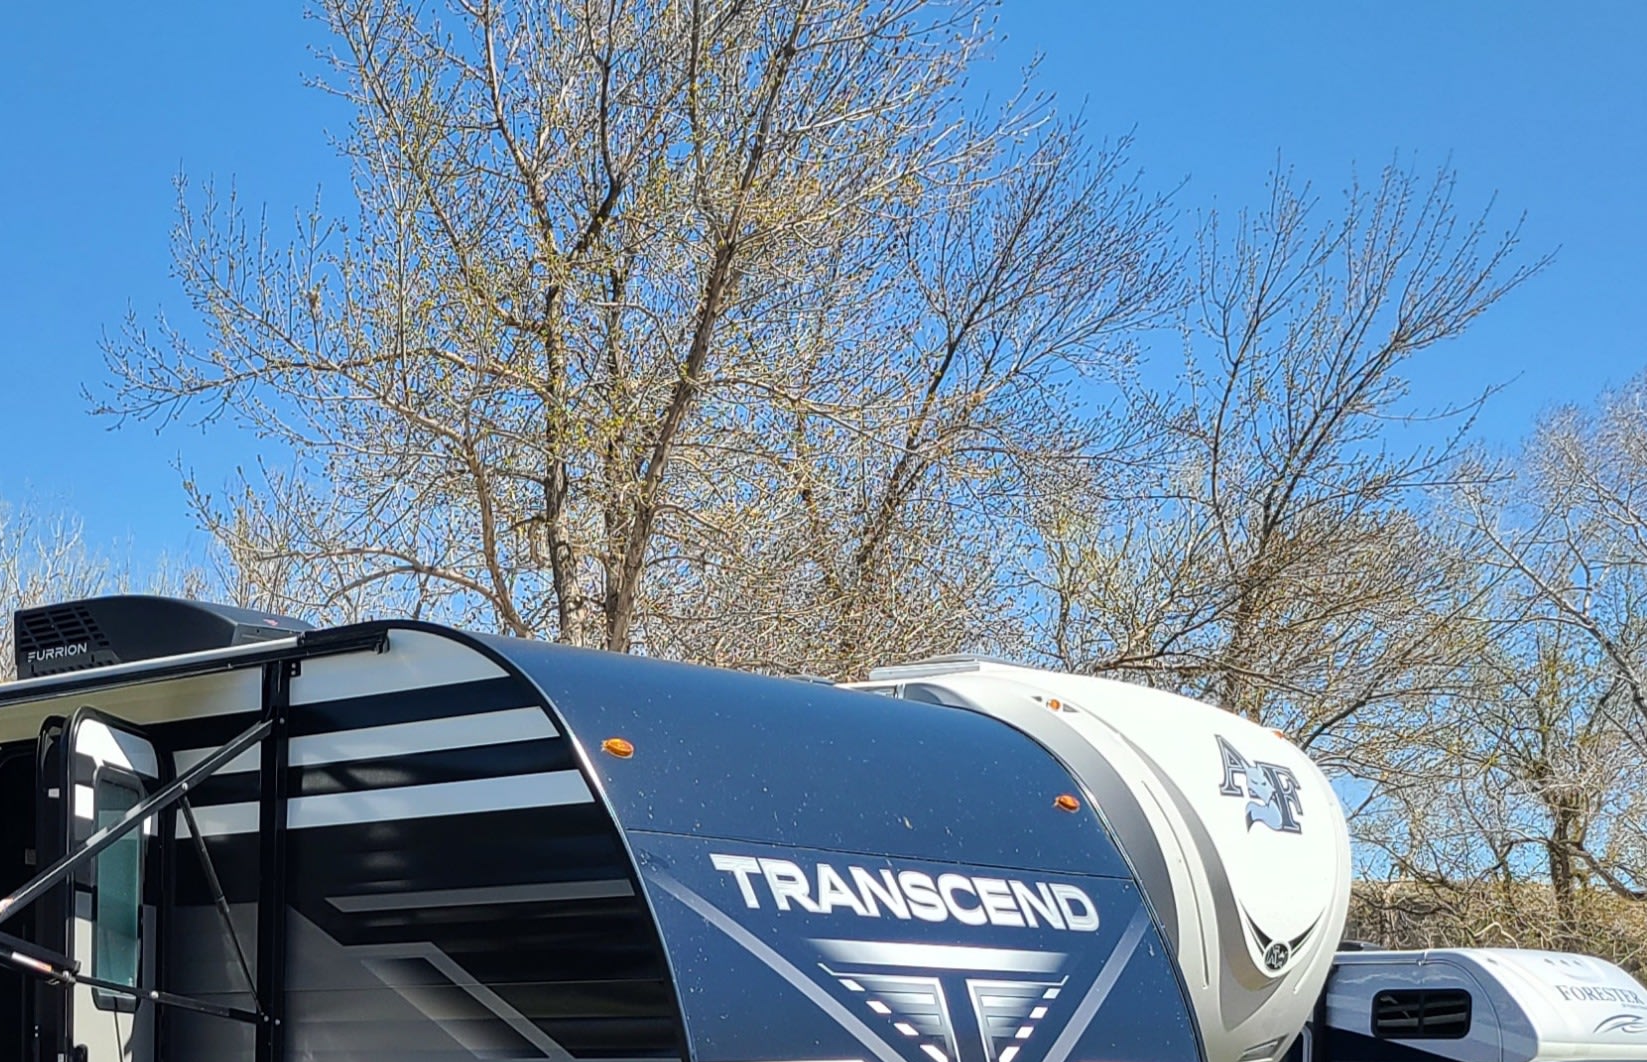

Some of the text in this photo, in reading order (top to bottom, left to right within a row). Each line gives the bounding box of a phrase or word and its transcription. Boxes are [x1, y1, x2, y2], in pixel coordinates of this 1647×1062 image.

[27, 642, 88, 663] FURRION
[708, 853, 1100, 932] TRANSCEND
[1554, 985, 1645, 1005] FORESTER
